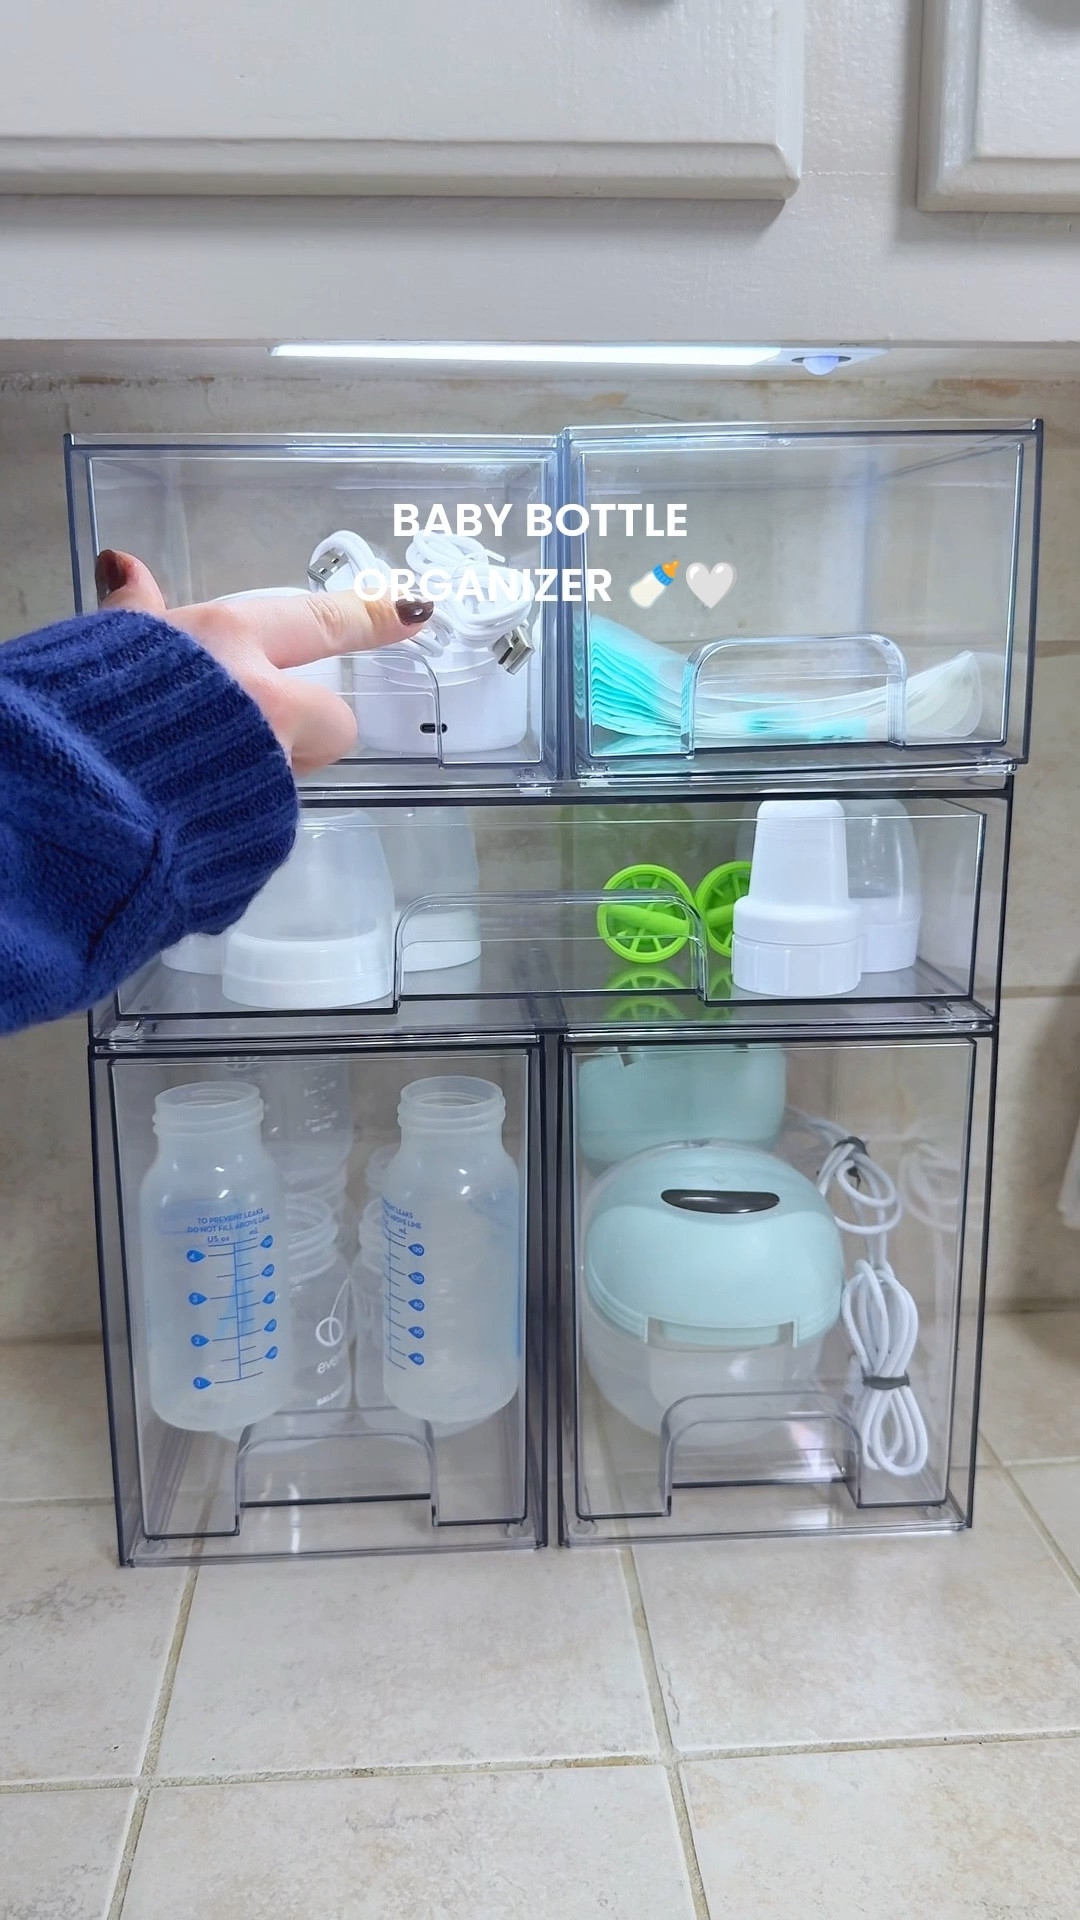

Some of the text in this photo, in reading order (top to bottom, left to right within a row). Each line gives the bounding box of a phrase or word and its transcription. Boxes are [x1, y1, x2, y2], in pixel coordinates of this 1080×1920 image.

[209, 1213, 243, 1224] PREVENT
[244, 1207, 264, 1218] LEAKS
[200, 1225, 216, 1233] NOT
[218, 1223, 234, 1232] FILL
[235, 1219, 258, 1229] ABOVE
[208, 1235, 219, 1243] US
